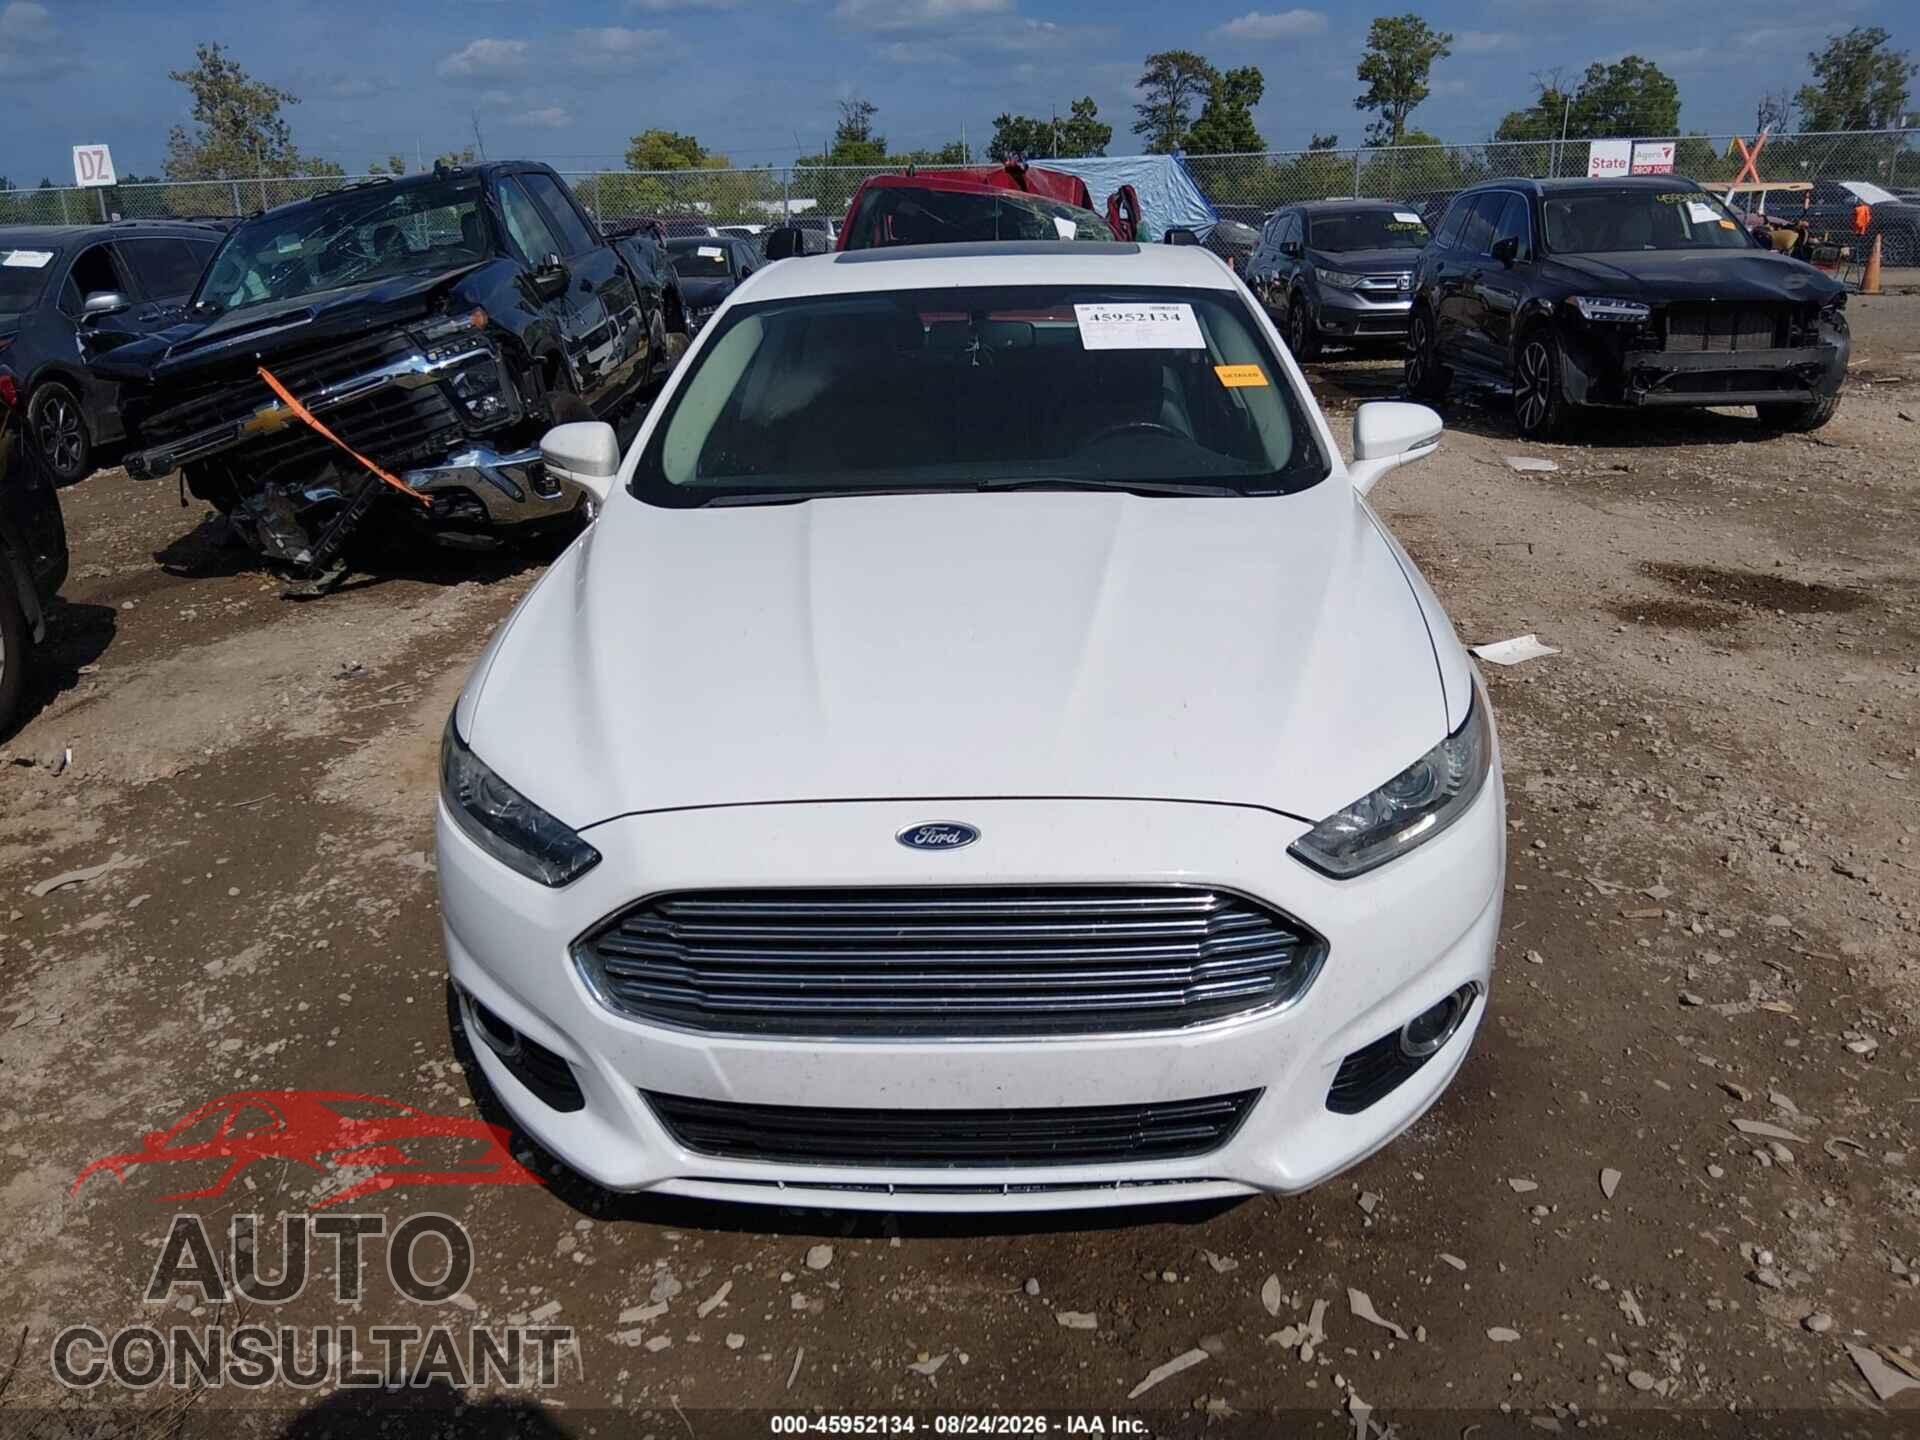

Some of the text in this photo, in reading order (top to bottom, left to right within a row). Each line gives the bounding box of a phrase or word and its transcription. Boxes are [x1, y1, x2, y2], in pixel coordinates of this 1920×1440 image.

[78, 150, 109, 180] DZ
[1592, 157, 1626, 169] State
[1633, 166, 1672, 175] DROP ZONE
[1090, 313, 1181, 321] 45952134
[914, 826, 961, 844] Ford
